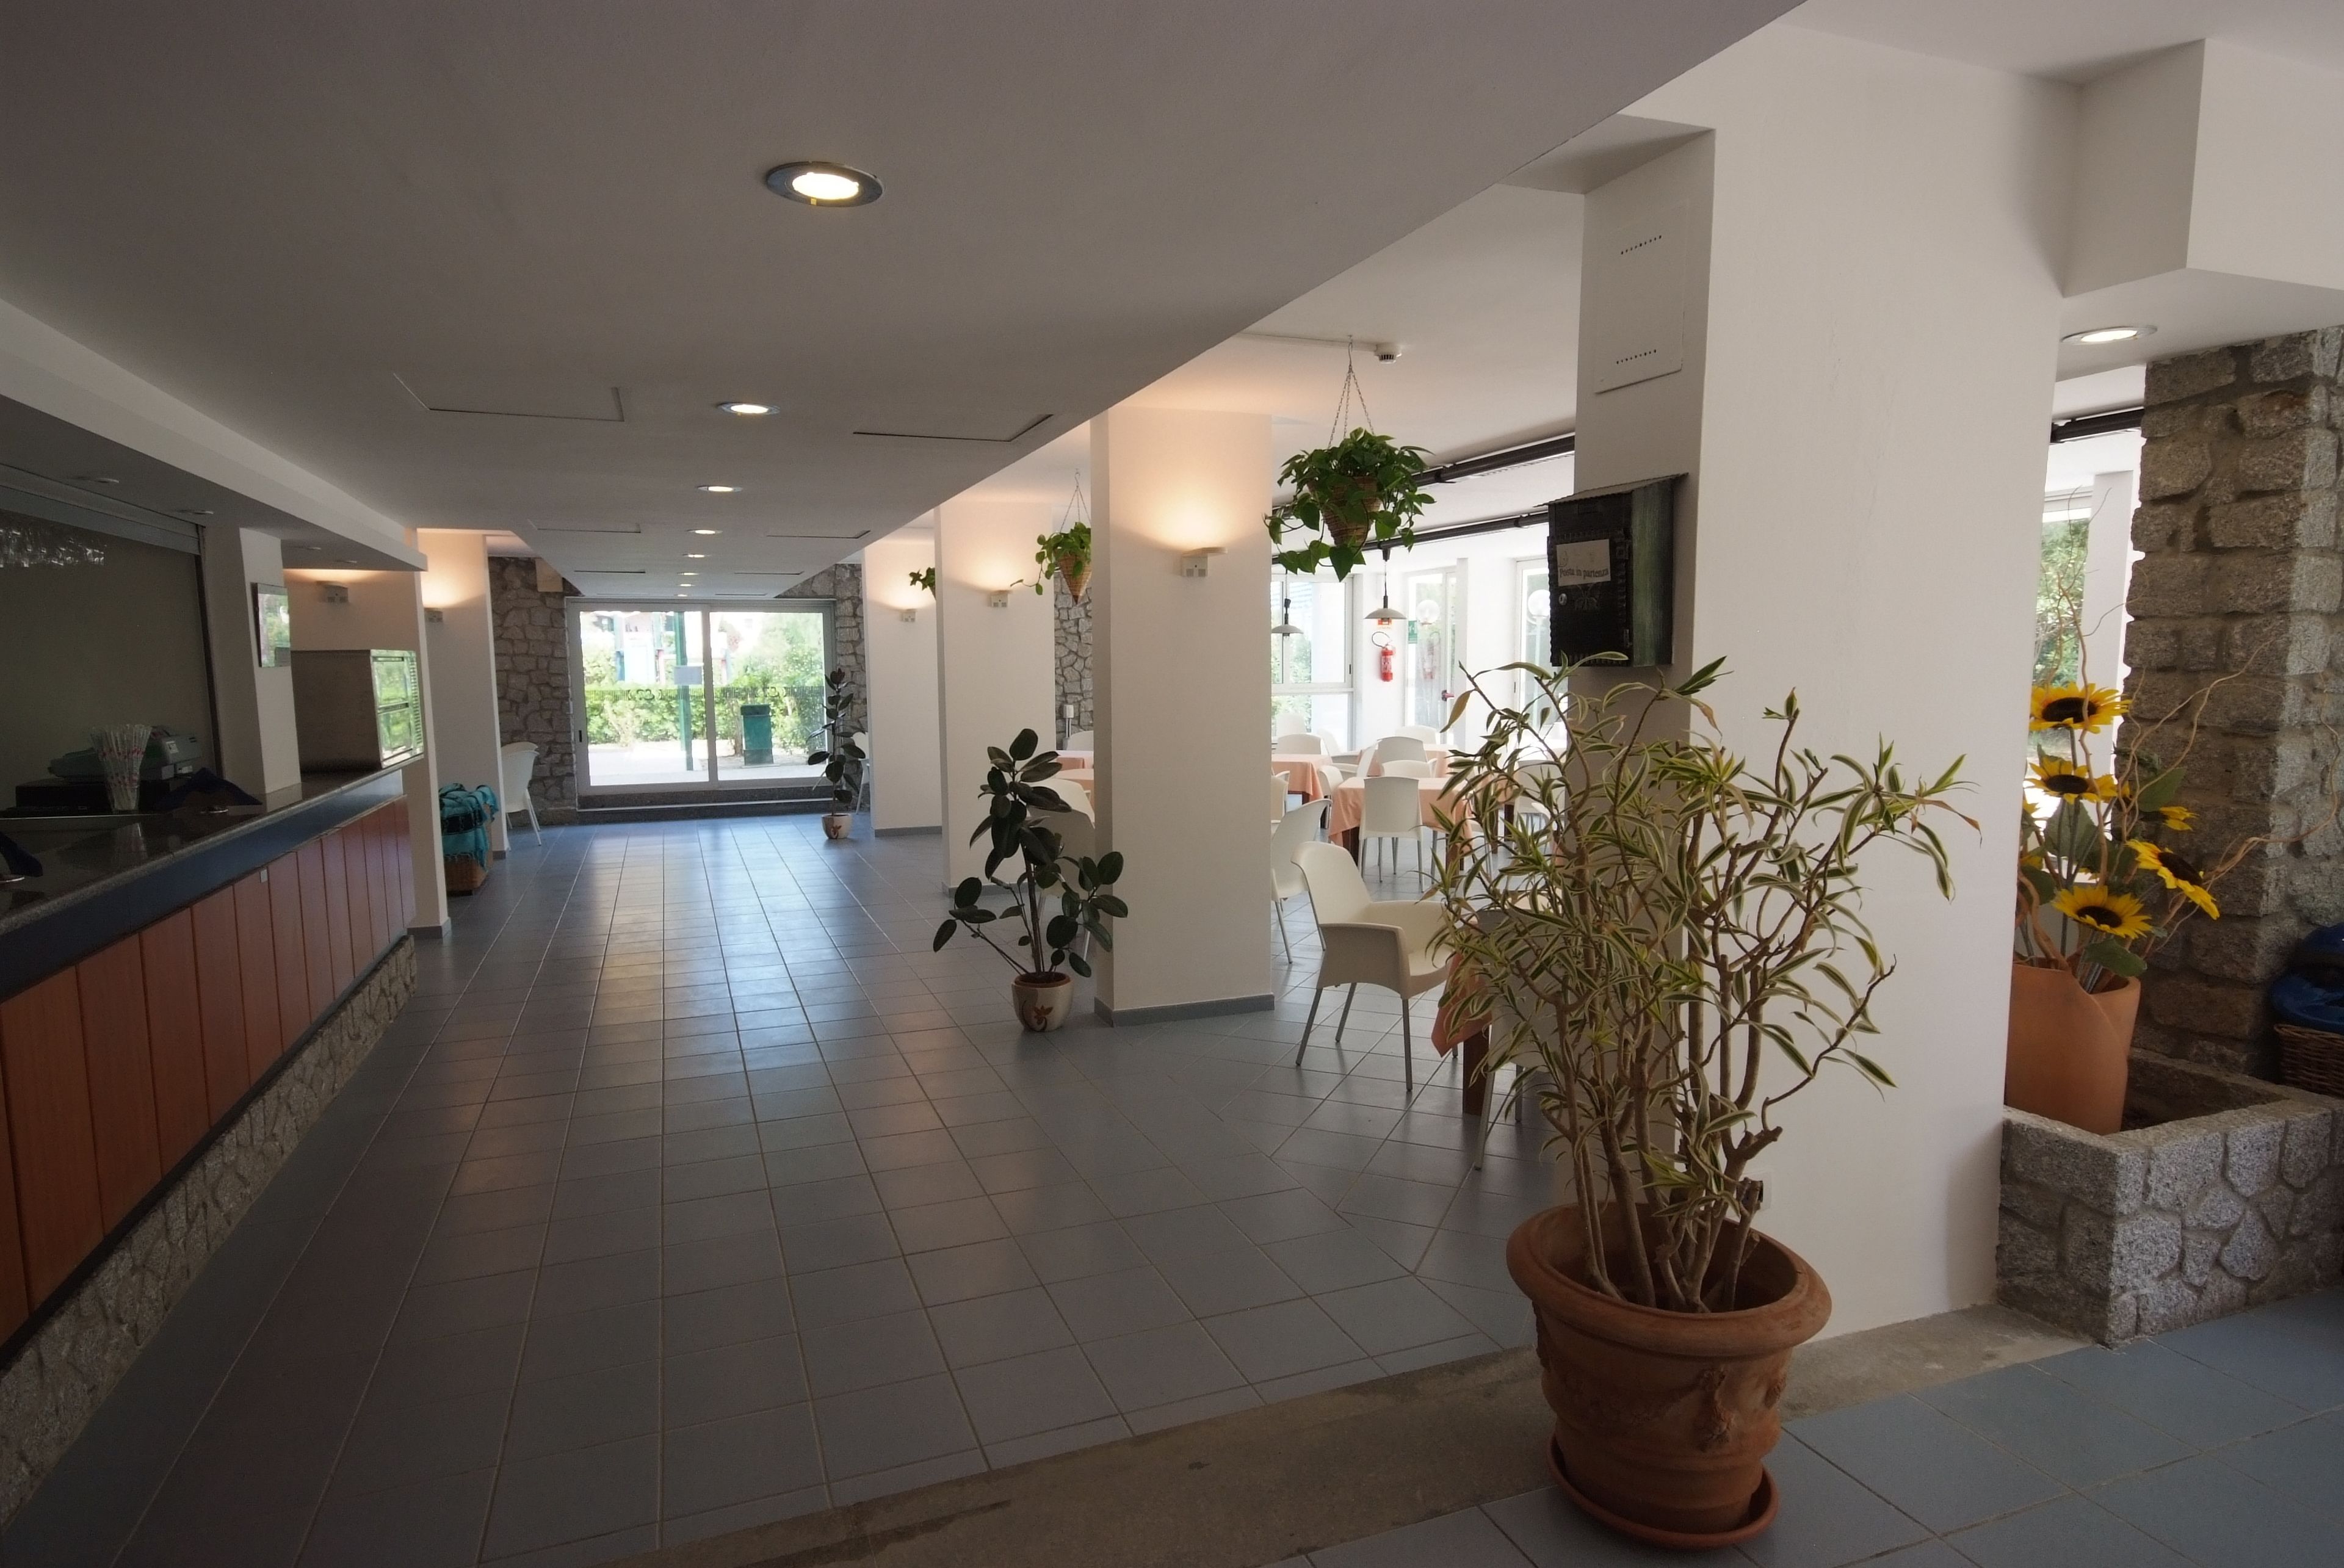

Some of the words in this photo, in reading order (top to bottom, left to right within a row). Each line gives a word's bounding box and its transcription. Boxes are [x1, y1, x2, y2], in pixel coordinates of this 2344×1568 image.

[1560, 568, 1575, 578] Posta
[1576, 566, 1582, 576] in
[1583, 568, 1608, 580] partenza
